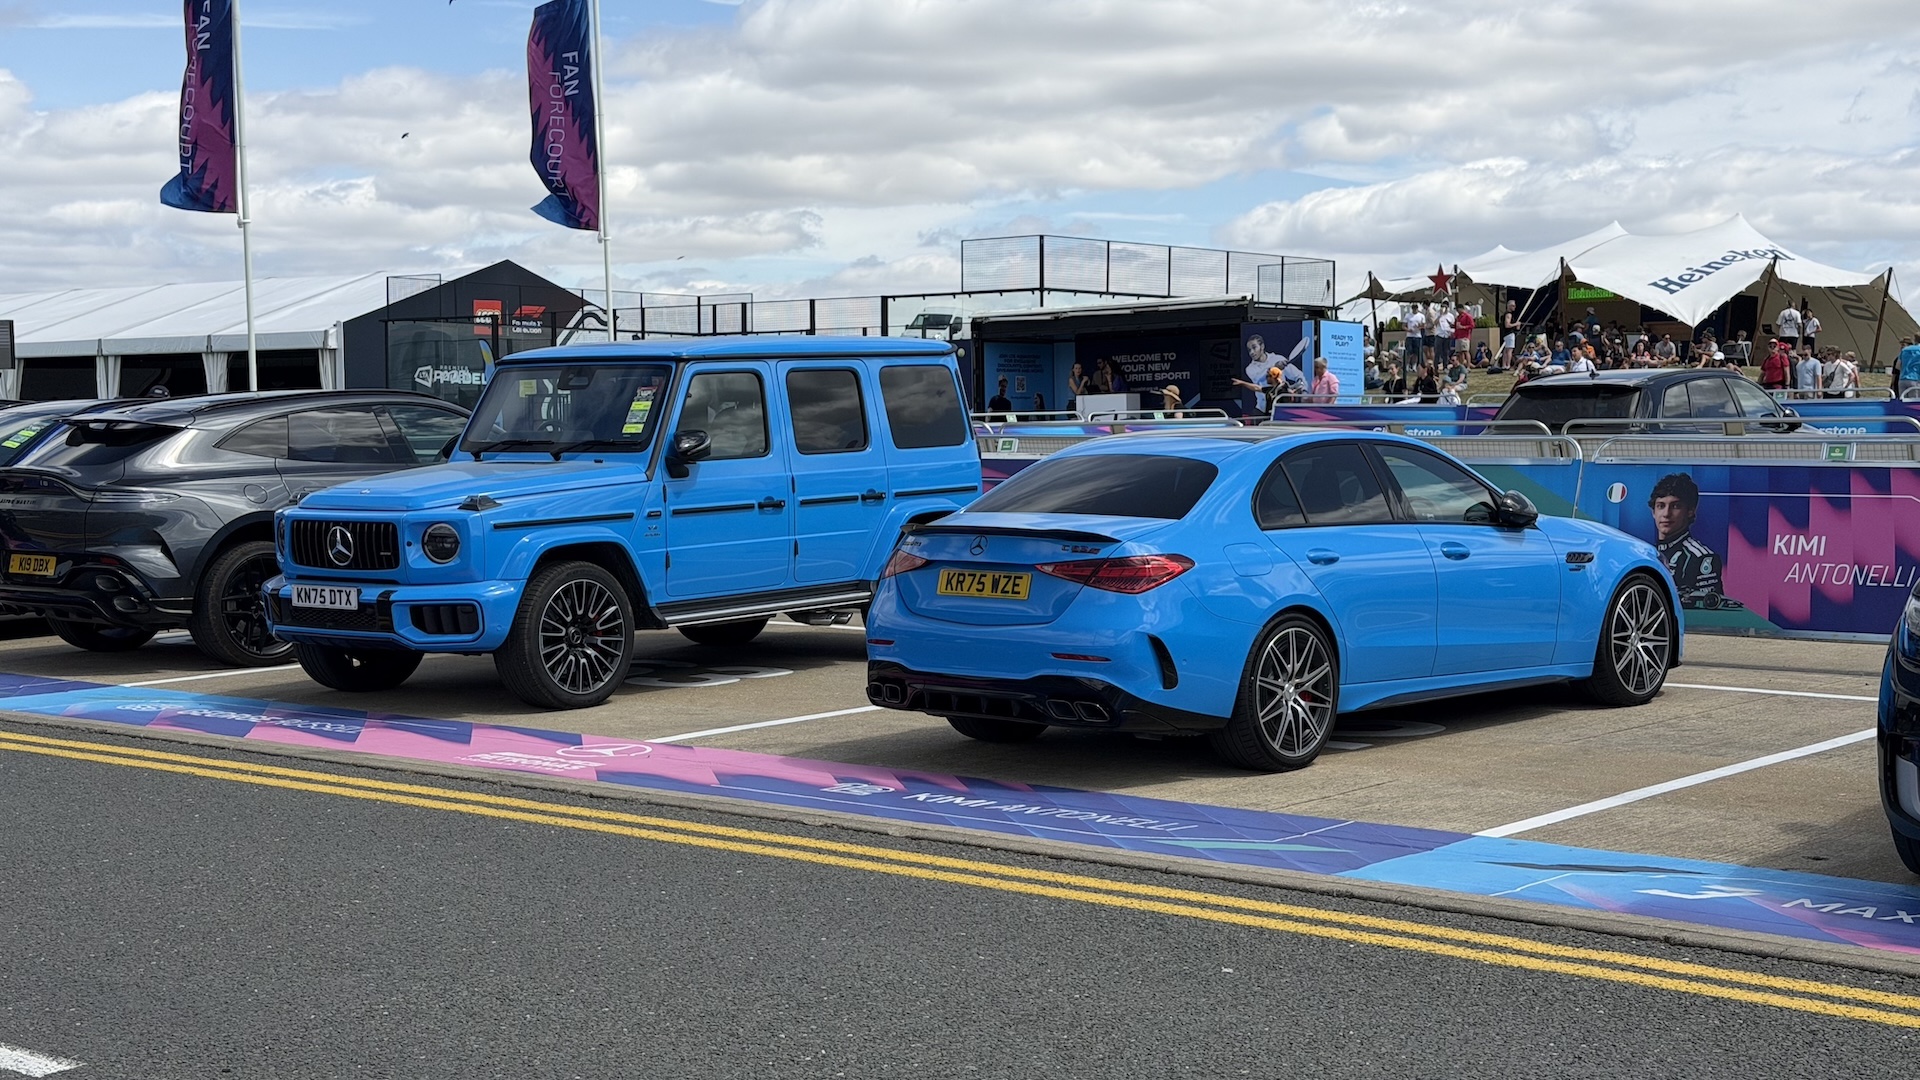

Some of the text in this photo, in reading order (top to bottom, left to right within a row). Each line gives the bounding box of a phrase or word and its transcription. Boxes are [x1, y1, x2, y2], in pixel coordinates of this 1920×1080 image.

[562, 51, 580, 97] FAN
[546, 71, 574, 201] FORECOURT
[1648, 244, 1796, 295] Heineken
[475, 309, 501, 324] LEG
[1112, 352, 1177, 363] WELCOME TO
[1147, 362, 1171, 371] NEW
[1125, 371, 1191, 382] URITE SPORT!
[1773, 534, 1826, 556] KIMI
[18, 557, 50, 572] K19 DBX
[1784, 562, 1916, 588] ANTONELLI
[945, 572, 1023, 595] KR75 WZE
[296, 587, 352, 606] KN75 DTX
[902, 792, 995, 809] KIMI
[986, 804, 1199, 832] ANTONELLI
[1781, 898, 1920, 924] MAX
